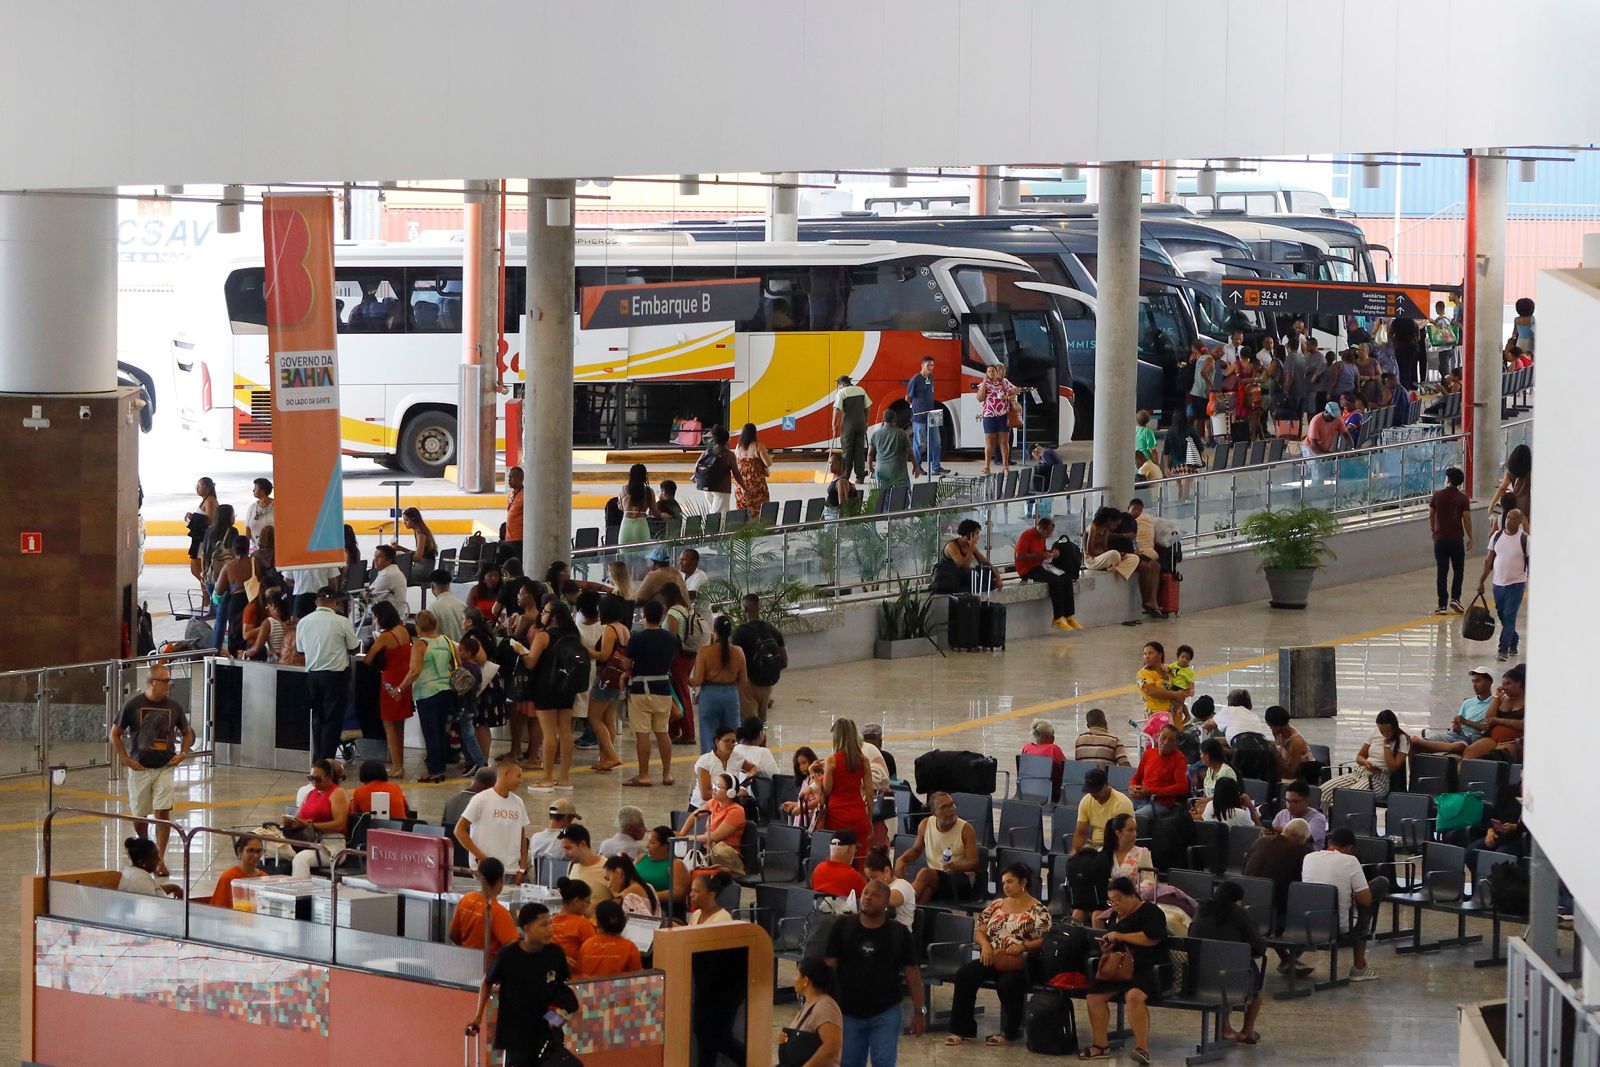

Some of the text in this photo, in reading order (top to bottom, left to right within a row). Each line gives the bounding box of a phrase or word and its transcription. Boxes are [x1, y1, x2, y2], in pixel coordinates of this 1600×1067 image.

[118, 218, 215, 247] CSAV
[1261, 290, 1271, 299] 32
[1279, 291, 1288, 300] 41
[632, 293, 711, 319] Embarque B
[280, 355, 320, 368] GOVERNO
[321, 355, 334, 366] DA
[281, 367, 335, 388] BAHIA
[295, 398, 309, 406] LADO
[308, 397, 316, 405] DA
[315, 396, 331, 405] GENTE
[493, 809, 519, 820] BOSS
